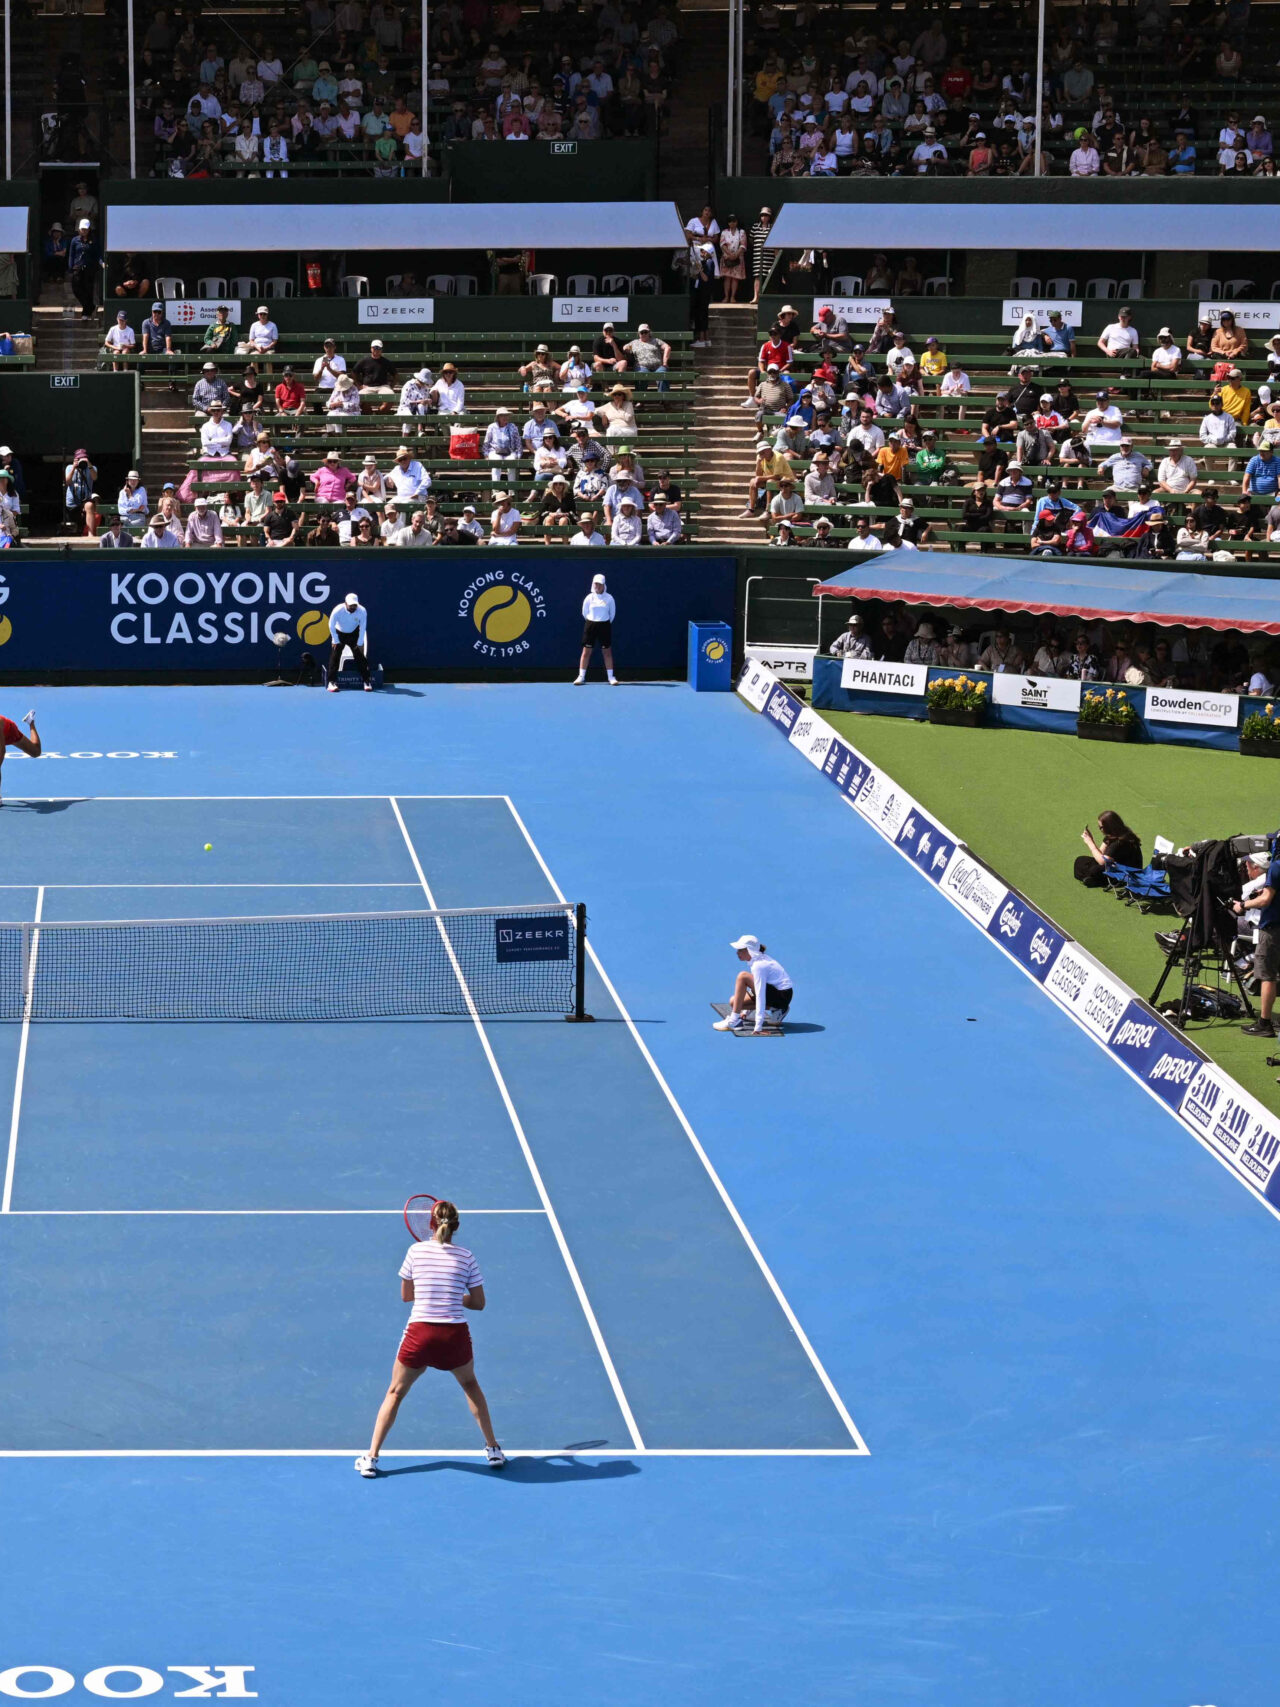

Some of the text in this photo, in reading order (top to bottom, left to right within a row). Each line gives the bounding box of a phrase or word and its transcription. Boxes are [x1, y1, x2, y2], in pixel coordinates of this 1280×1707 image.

[554, 143, 574, 153] EXIT
[382, 307, 425, 315] ZEEKR
[577, 305, 619, 313] ZEEKR
[1234, 311, 1271, 319] EEKR
[54, 376, 75, 386] EXIT
[111, 571, 331, 605] KOOYONG
[458, 571, 546, 617] KOOYONG CLASSIC
[110, 611, 292, 644] CLASSIC
[1021, 688, 1048, 698] SAINT
[1151, 695, 1232, 716] BowdenCorp
[515, 930, 564, 939] ZEEKR
[1061, 953, 1089, 985] KOOYONG
[1051, 969, 1077, 998] CLASSIC
[1084, 999, 1111, 1029] CLASSIC
[1094, 983, 1124, 1017] KOOYONG
[1113, 1019, 1158, 1048] APEROL
[1149, 1053, 1198, 1084] APEROL
[1187, 1099, 1211, 1126] MELBOURNE
[1214, 1126, 1239, 1153] MELBOURNE
[1241, 1152, 1268, 1181] MELBOURNE
